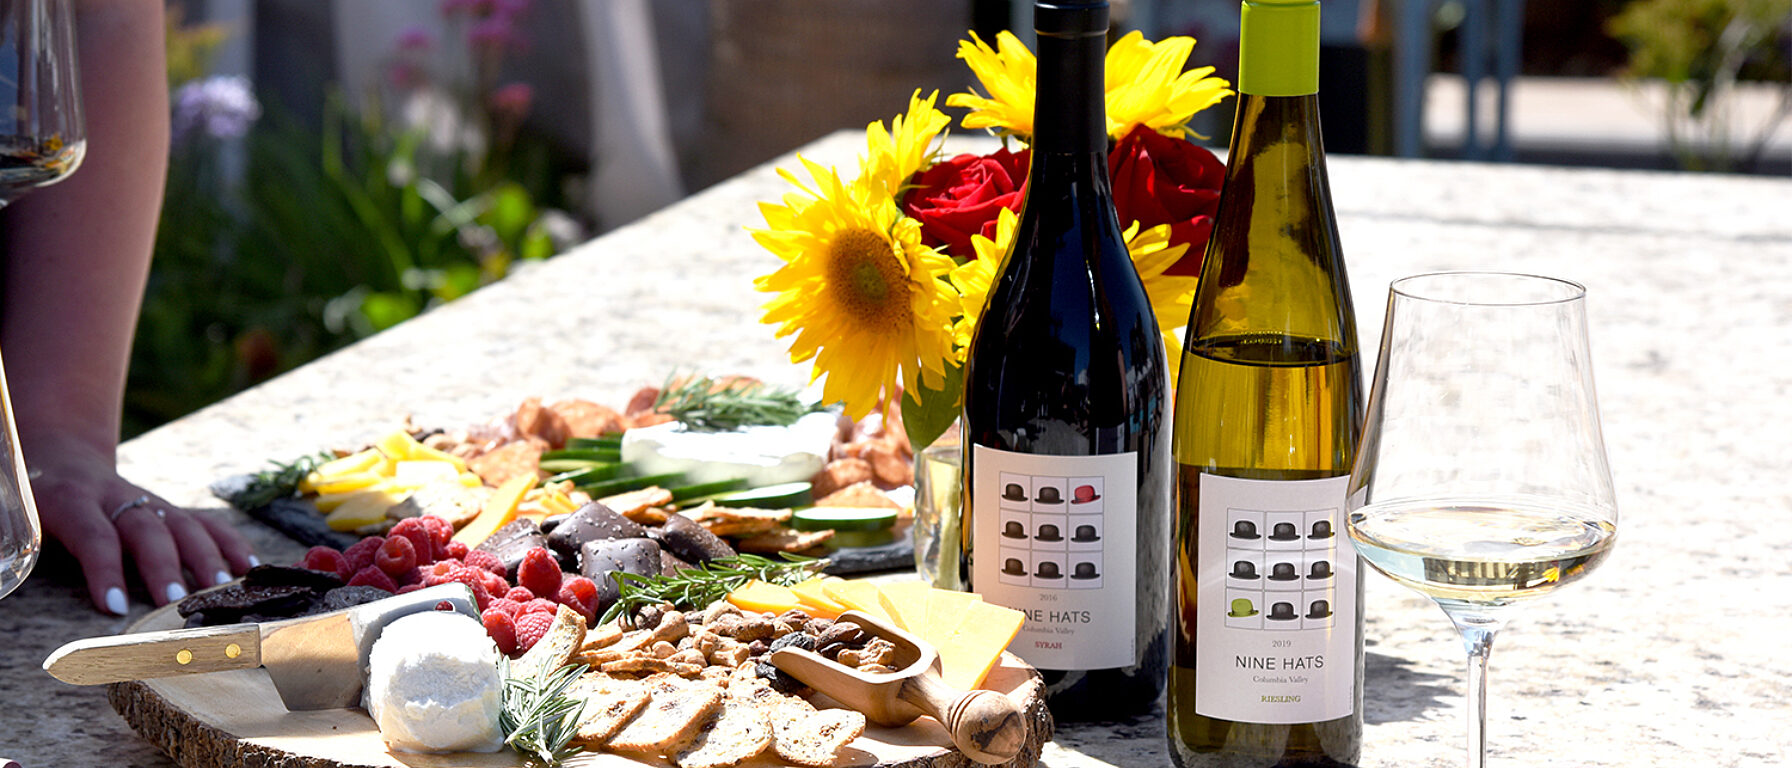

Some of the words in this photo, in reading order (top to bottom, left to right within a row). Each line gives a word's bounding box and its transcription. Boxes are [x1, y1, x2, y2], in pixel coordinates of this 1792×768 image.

[1040, 594, 1058, 602] 2016
[1049, 610, 1091, 624] HATS
[1022, 625, 1054, 634] Columbia
[1055, 627, 1075, 636] Valley
[1035, 641, 1063, 650] SYRAH
[1272, 640, 1291, 648] 2019
[1235, 655, 1276, 670] NINE
[1283, 655, 1324, 670] HATS
[1252, 675, 1288, 684] Columbia
[1289, 676, 1308, 684] Valley
[1261, 695, 1301, 703] RIESLING
